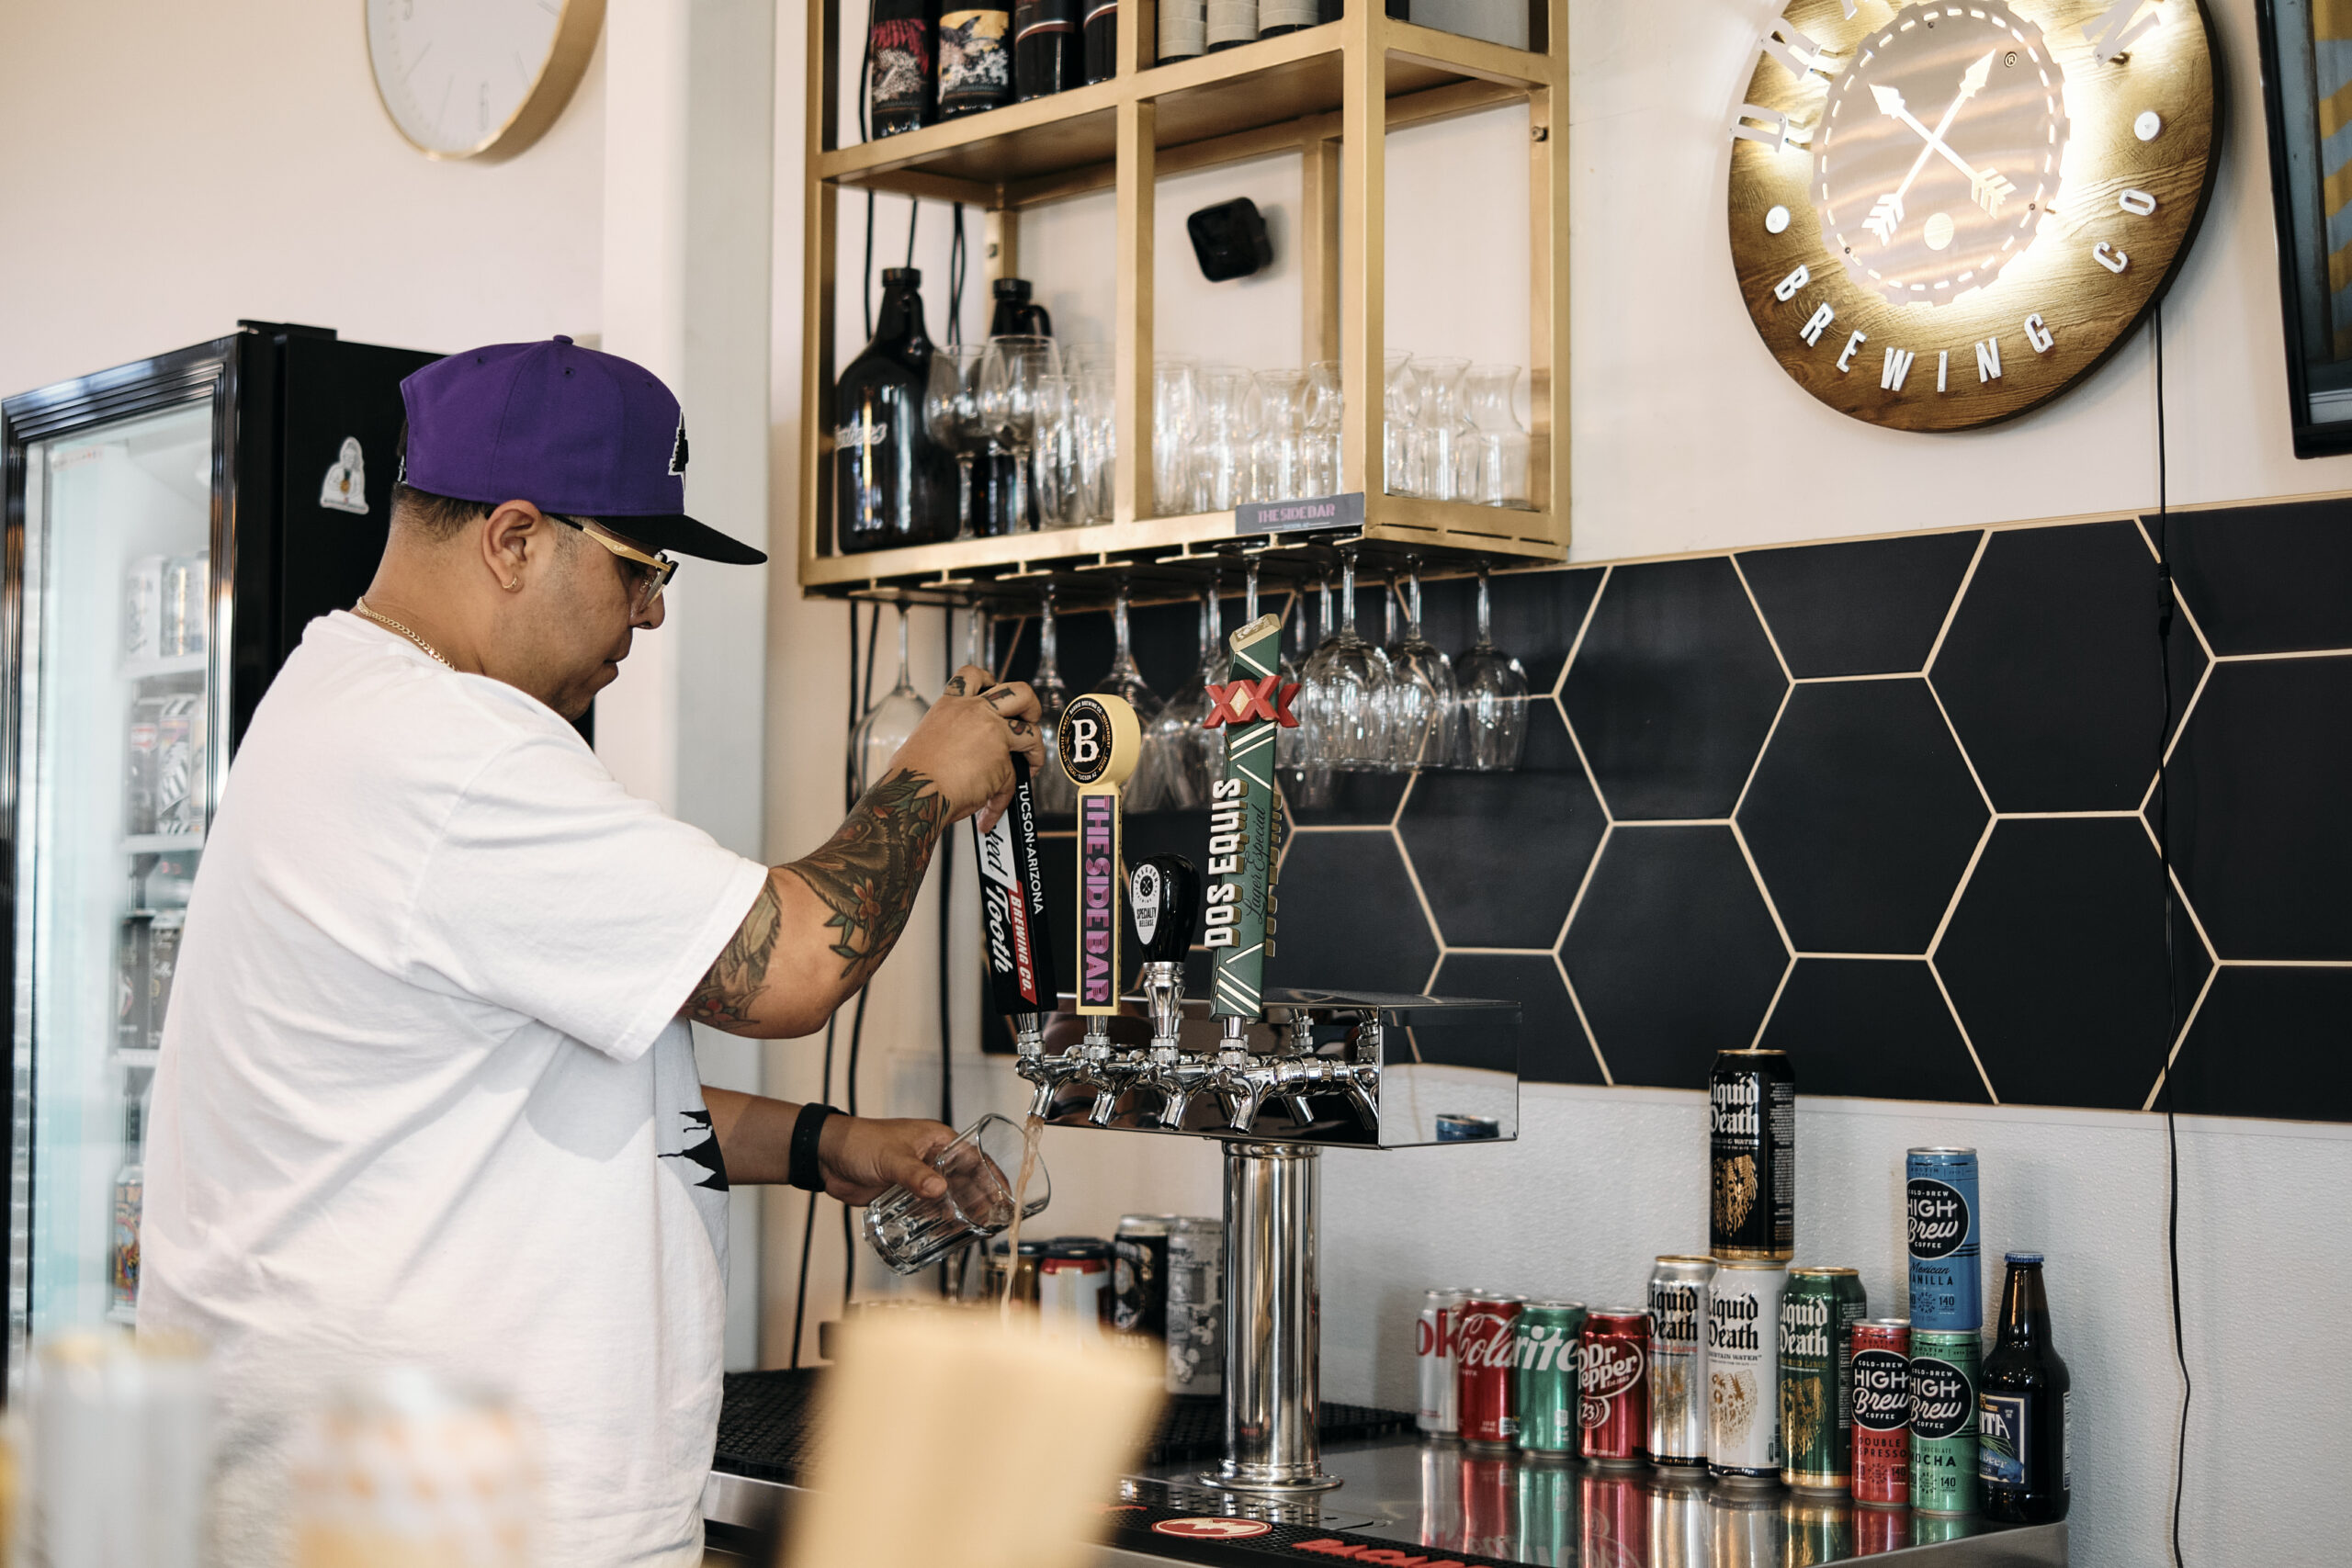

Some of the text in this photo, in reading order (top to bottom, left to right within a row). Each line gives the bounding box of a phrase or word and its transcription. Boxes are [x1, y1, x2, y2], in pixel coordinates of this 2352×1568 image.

[1774, 189, 2156, 392] BREWING CO
[1258, 509, 1279, 524] THE
[1071, 718, 1100, 763] B
[1086, 795, 1110, 854] THE
[1204, 778, 1248, 948] DOS EQUIS
[1242, 803, 1270, 925] Lager Especial
[1136, 907, 1157, 919] SPECIALTY
[1138, 919, 1154, 928] RELEASE
[986, 886, 1013, 974] Tooth
[1011, 895, 1032, 991] BREWING CO.
[1908, 1216, 1959, 1244] Brew
[1910, 1261, 1951, 1275] Mexican
[1909, 1274, 1953, 1286] ANILLA
[1709, 1291, 1758, 1326] iquid
[1939, 1295, 1955, 1306] 140
[1589, 1343, 1617, 1369] Dr
[1858, 1359, 1904, 1368] COLD-BREW
[1577, 1348, 1638, 1393] Pepper
[1854, 1368, 1909, 1389] HIGH
[1910, 1376, 1962, 1398] HIGH
[1581, 1402, 1595, 1420] 23
[1852, 1387, 1909, 1415] Brew
[1910, 1394, 1962, 1423] Brew
[1865, 1412, 1895, 1420] COFFEE
[1917, 1421, 1945, 1429] COFFEE
[1859, 1437, 1901, 1448] DOUBLE
[1983, 1450, 2007, 1469] Beer
[1892, 1467, 1906, 1477] 140
[1940, 1477, 1956, 1487] 140
